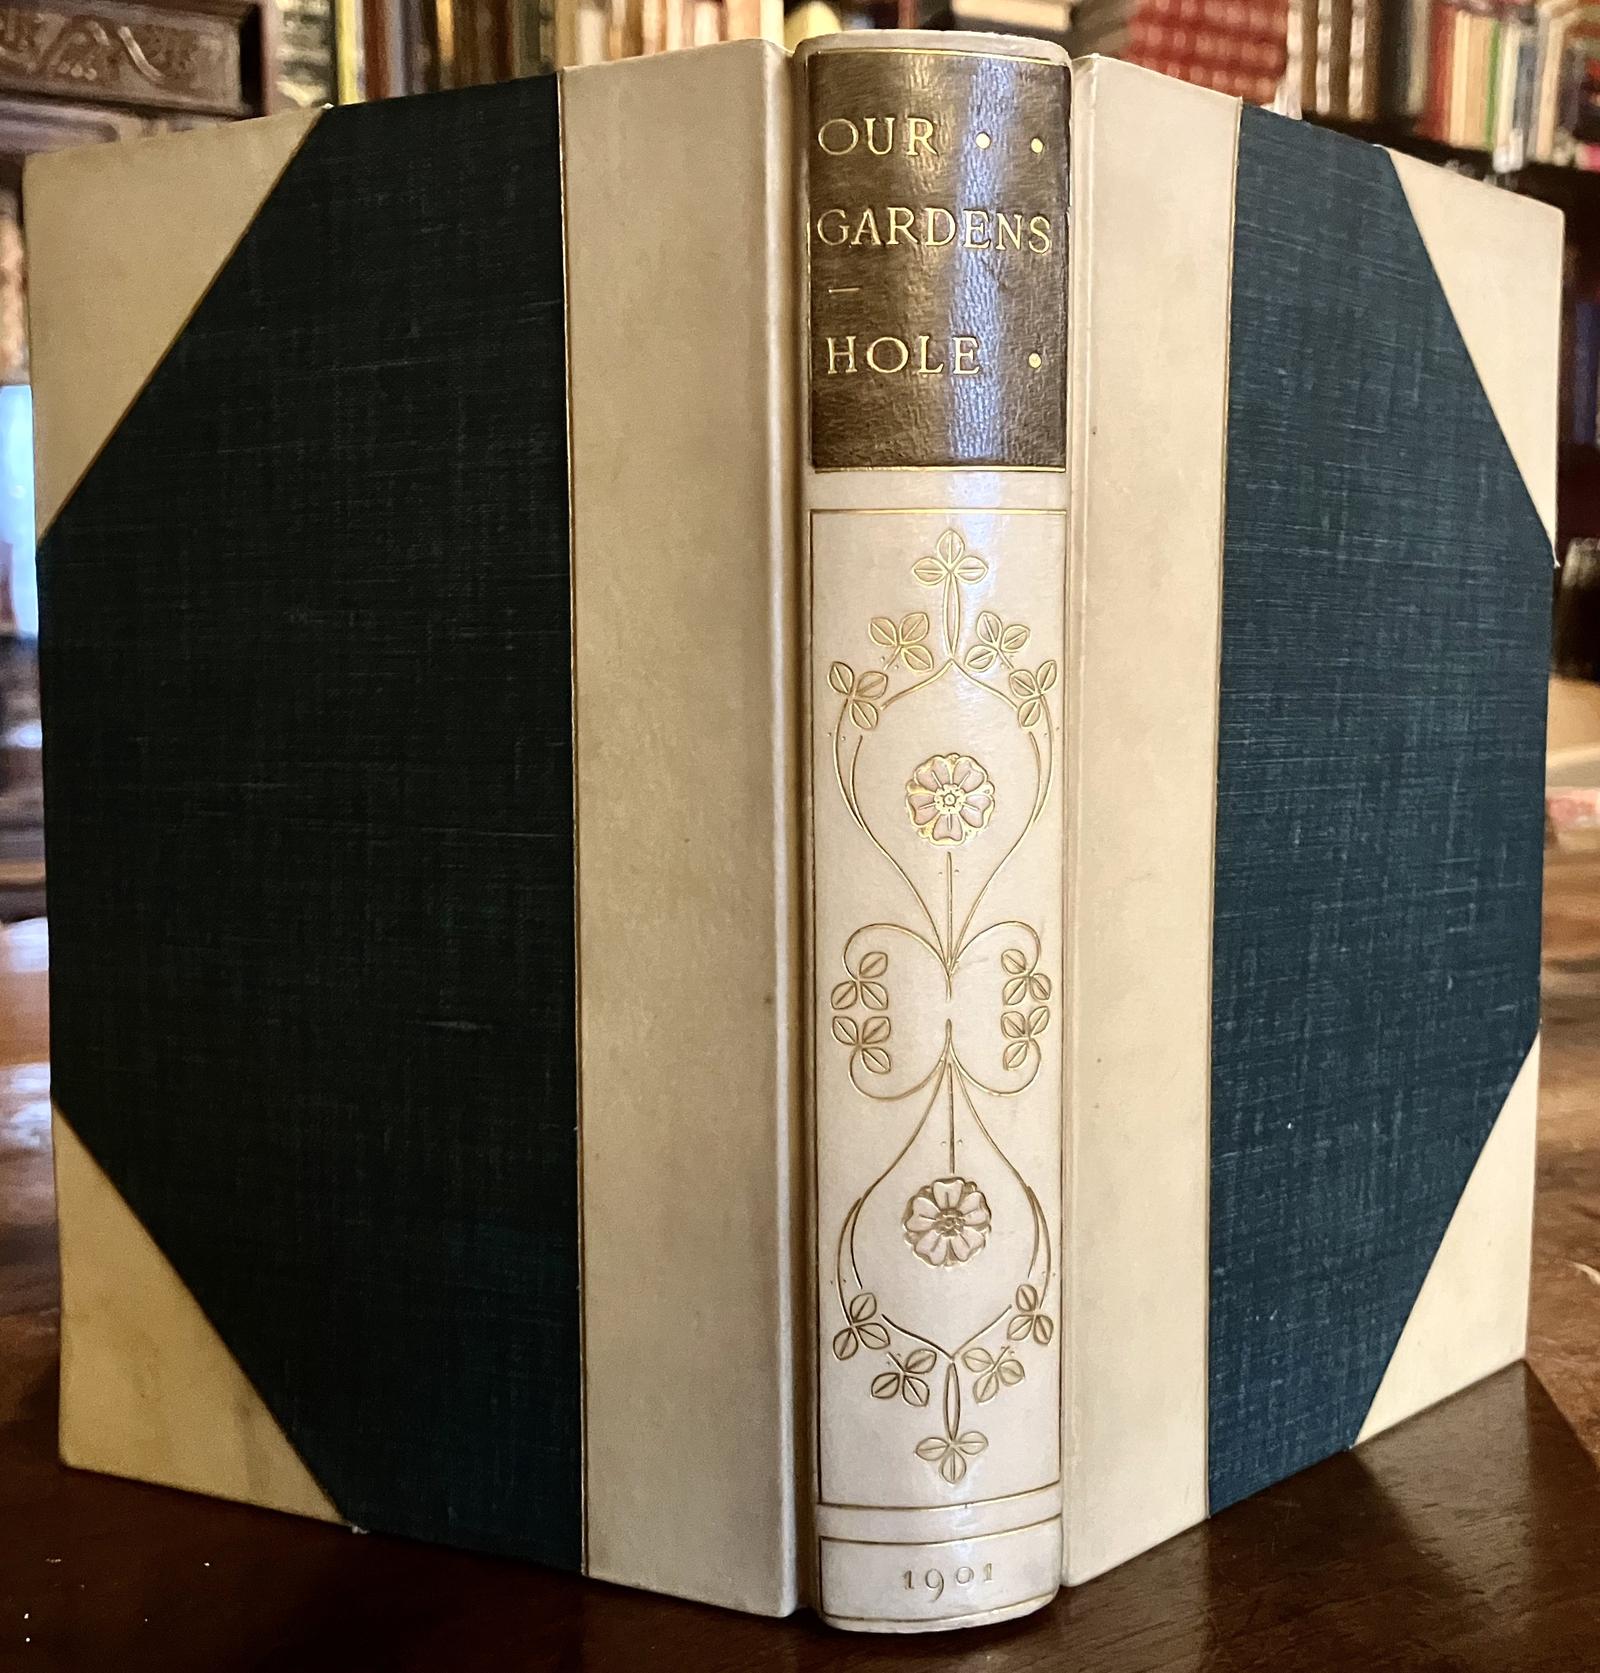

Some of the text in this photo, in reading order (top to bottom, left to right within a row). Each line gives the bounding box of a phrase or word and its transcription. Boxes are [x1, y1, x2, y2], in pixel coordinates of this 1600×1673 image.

[818, 117, 938, 156] OUR
[817, 207, 1052, 254] GARDENS
[827, 336, 980, 375] HOLE
[902, 1562, 993, 1602] 1901
